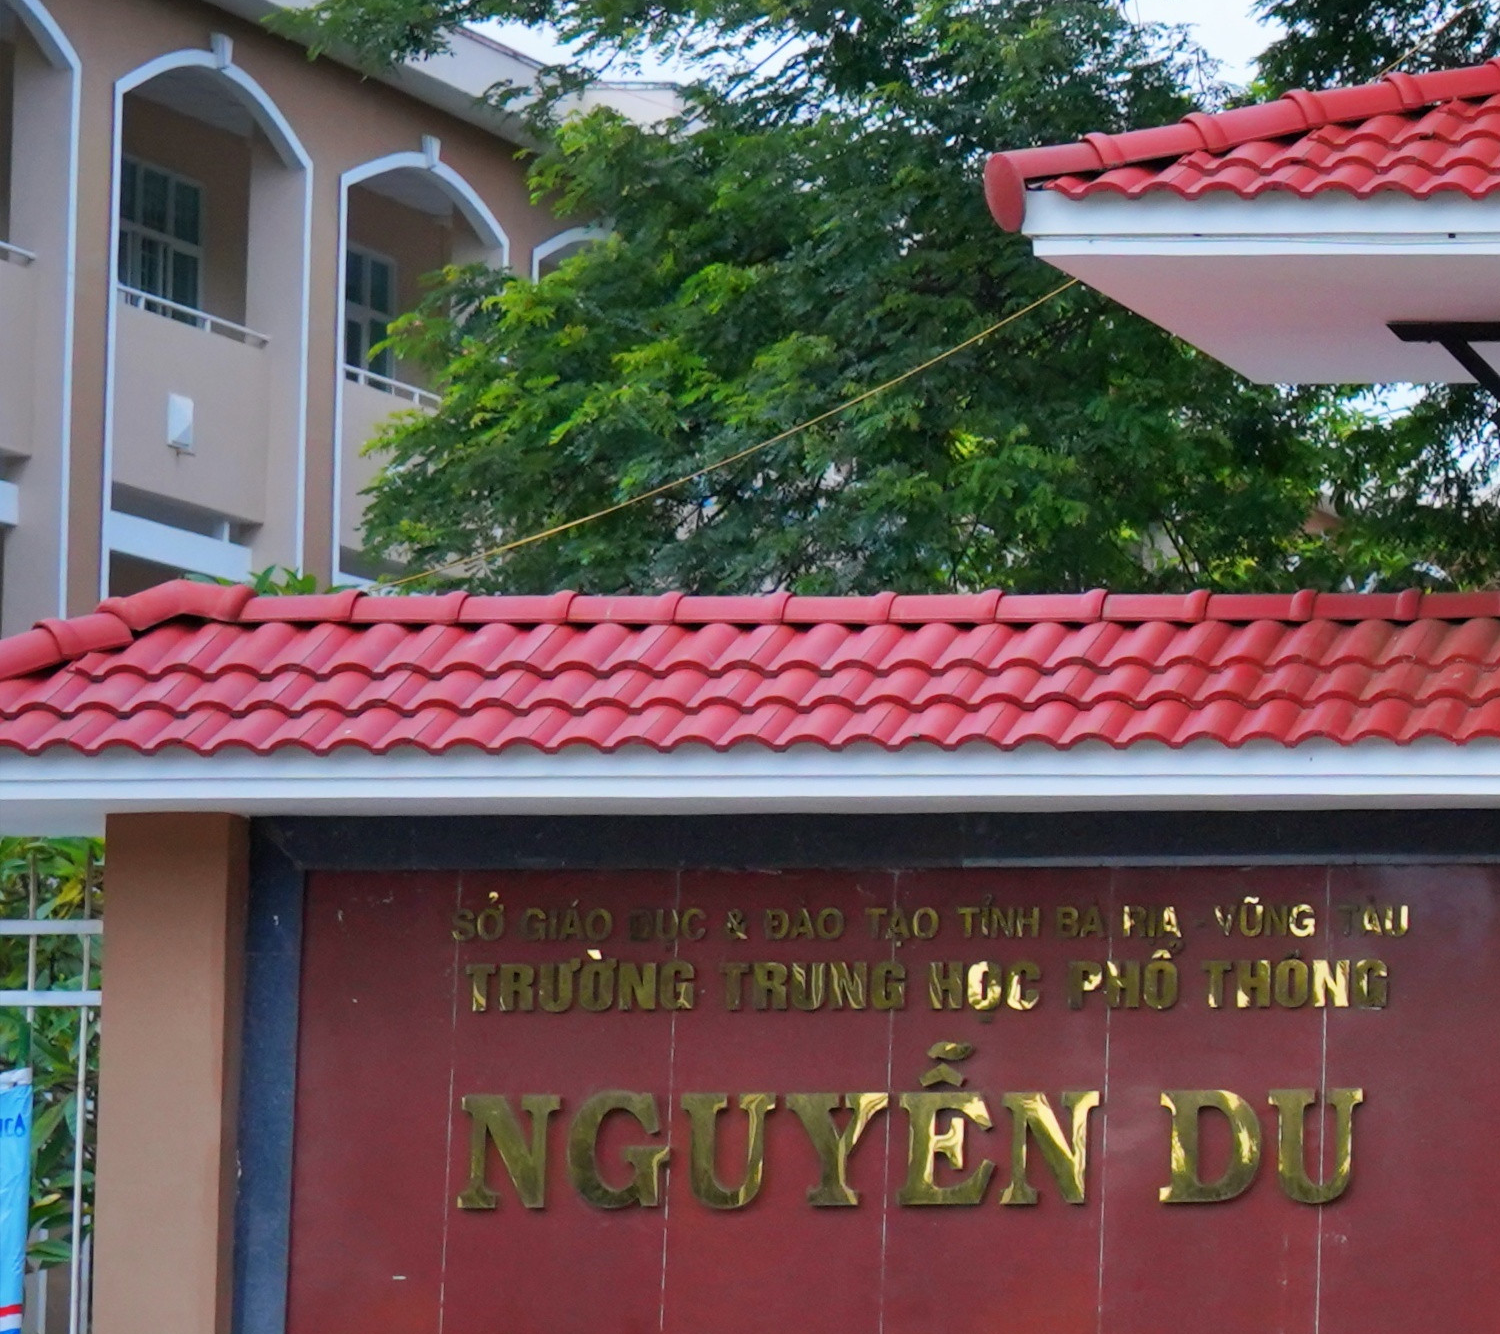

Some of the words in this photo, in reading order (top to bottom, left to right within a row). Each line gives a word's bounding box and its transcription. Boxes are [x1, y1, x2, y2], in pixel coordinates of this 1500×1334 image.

[450, 891, 505, 942] SỞ
[518, 898, 613, 942] GIÁO
[628, 907, 707, 951] DỤC
[864, 906, 940, 949] TẠO
[957, 892, 1041, 939] TỈNH
[1212, 895, 1317, 939] VŨNG
[465, 948, 695, 1013] TRƯỜNG
[719, 961, 907, 1012] TRUNG
[928, 960, 1043, 1023] HỌC
[1068, 938, 1185, 1011] PHỔ
[1203, 949, 1391, 1011] THÔNG
[456, 1041, 1102, 1211] NGUYỄN
[1157, 1086, 1365, 1208] DU
